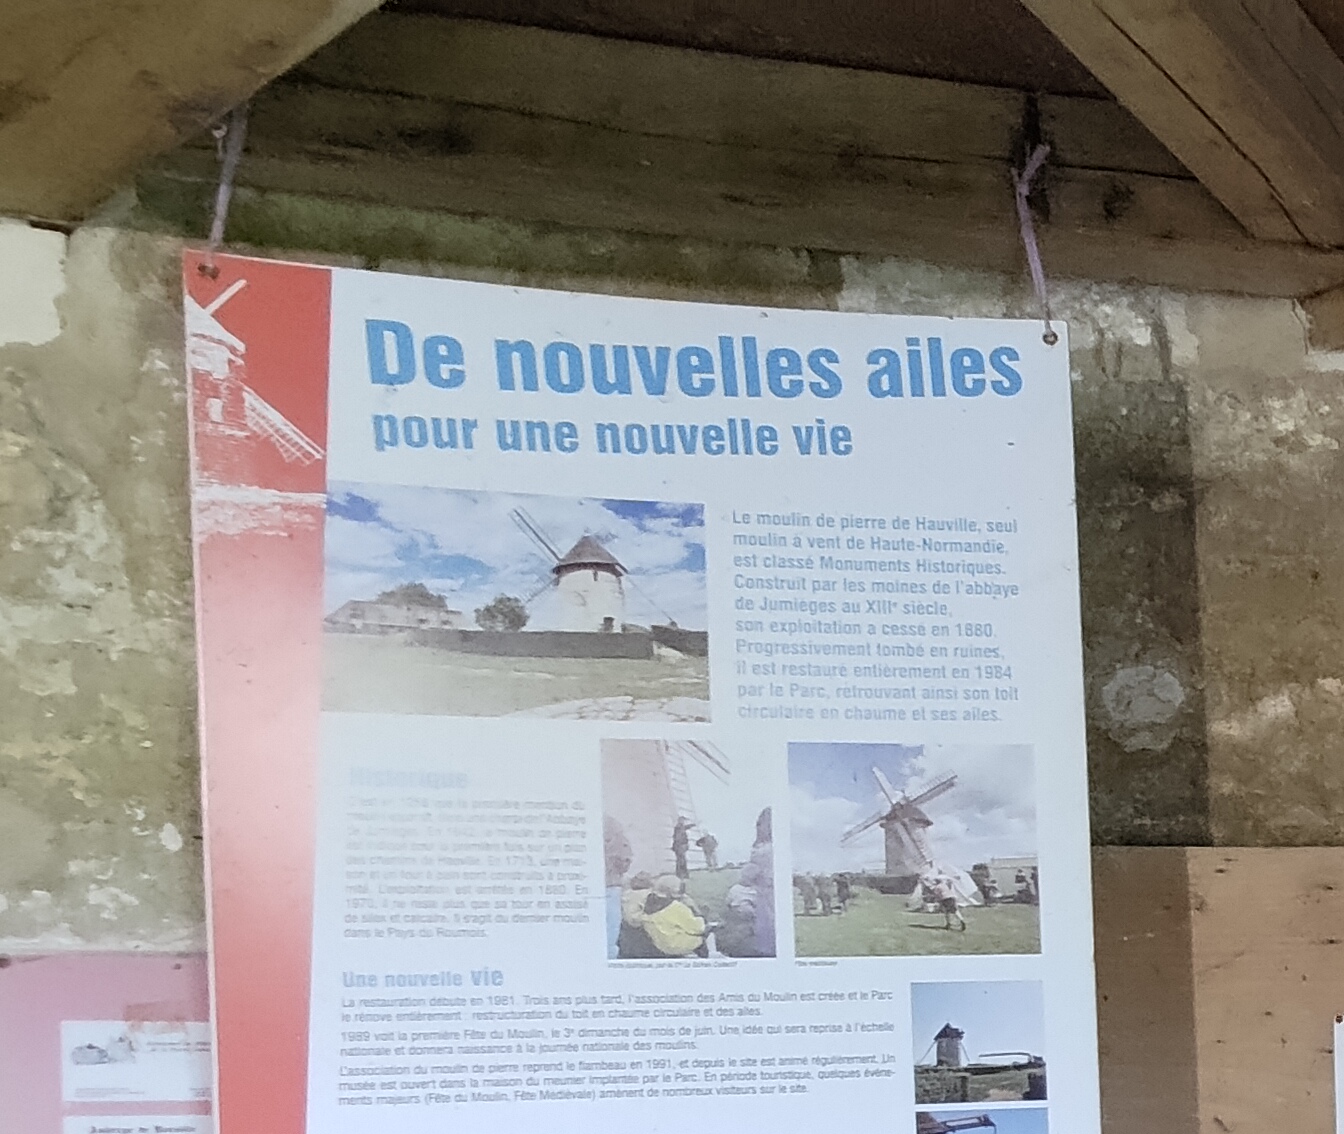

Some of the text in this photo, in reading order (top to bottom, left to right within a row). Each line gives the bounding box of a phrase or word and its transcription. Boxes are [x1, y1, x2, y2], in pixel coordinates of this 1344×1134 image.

[365, 318, 1023, 399] De nouvelles ailes
[373, 415, 853, 457] pour une nouvelle vie
[732, 510, 1017, 534] Le moulin de pierre de Hauville, seul
[733, 531, 1008, 556] moulin à vent de Haute-Normandie,
[733, 553, 1005, 577] est classé Monuments Historiques.
[734, 575, 1020, 599] Construit par les moines de l'abbaye
[734, 595, 754, 610] de
[841, 602, 860, 613] au
[903, 600, 952, 618] siècle,
[735, 621, 763, 632] son
[769, 618, 862, 637] exploitation
[867, 624, 876, 634] a
[931, 625, 949, 636] en
[736, 638, 1004, 660] Progressivement tombé en ruines,
[736, 659, 1011, 679] il est restauré entièrement en 1984
[737, 682, 1018, 700] par le Parc, retrouvant ainsi son toit
[738, 703, 1001, 721] circulaire en chaume et ses ailes.
[342, 967, 503, 986] Une nouvelle vie
